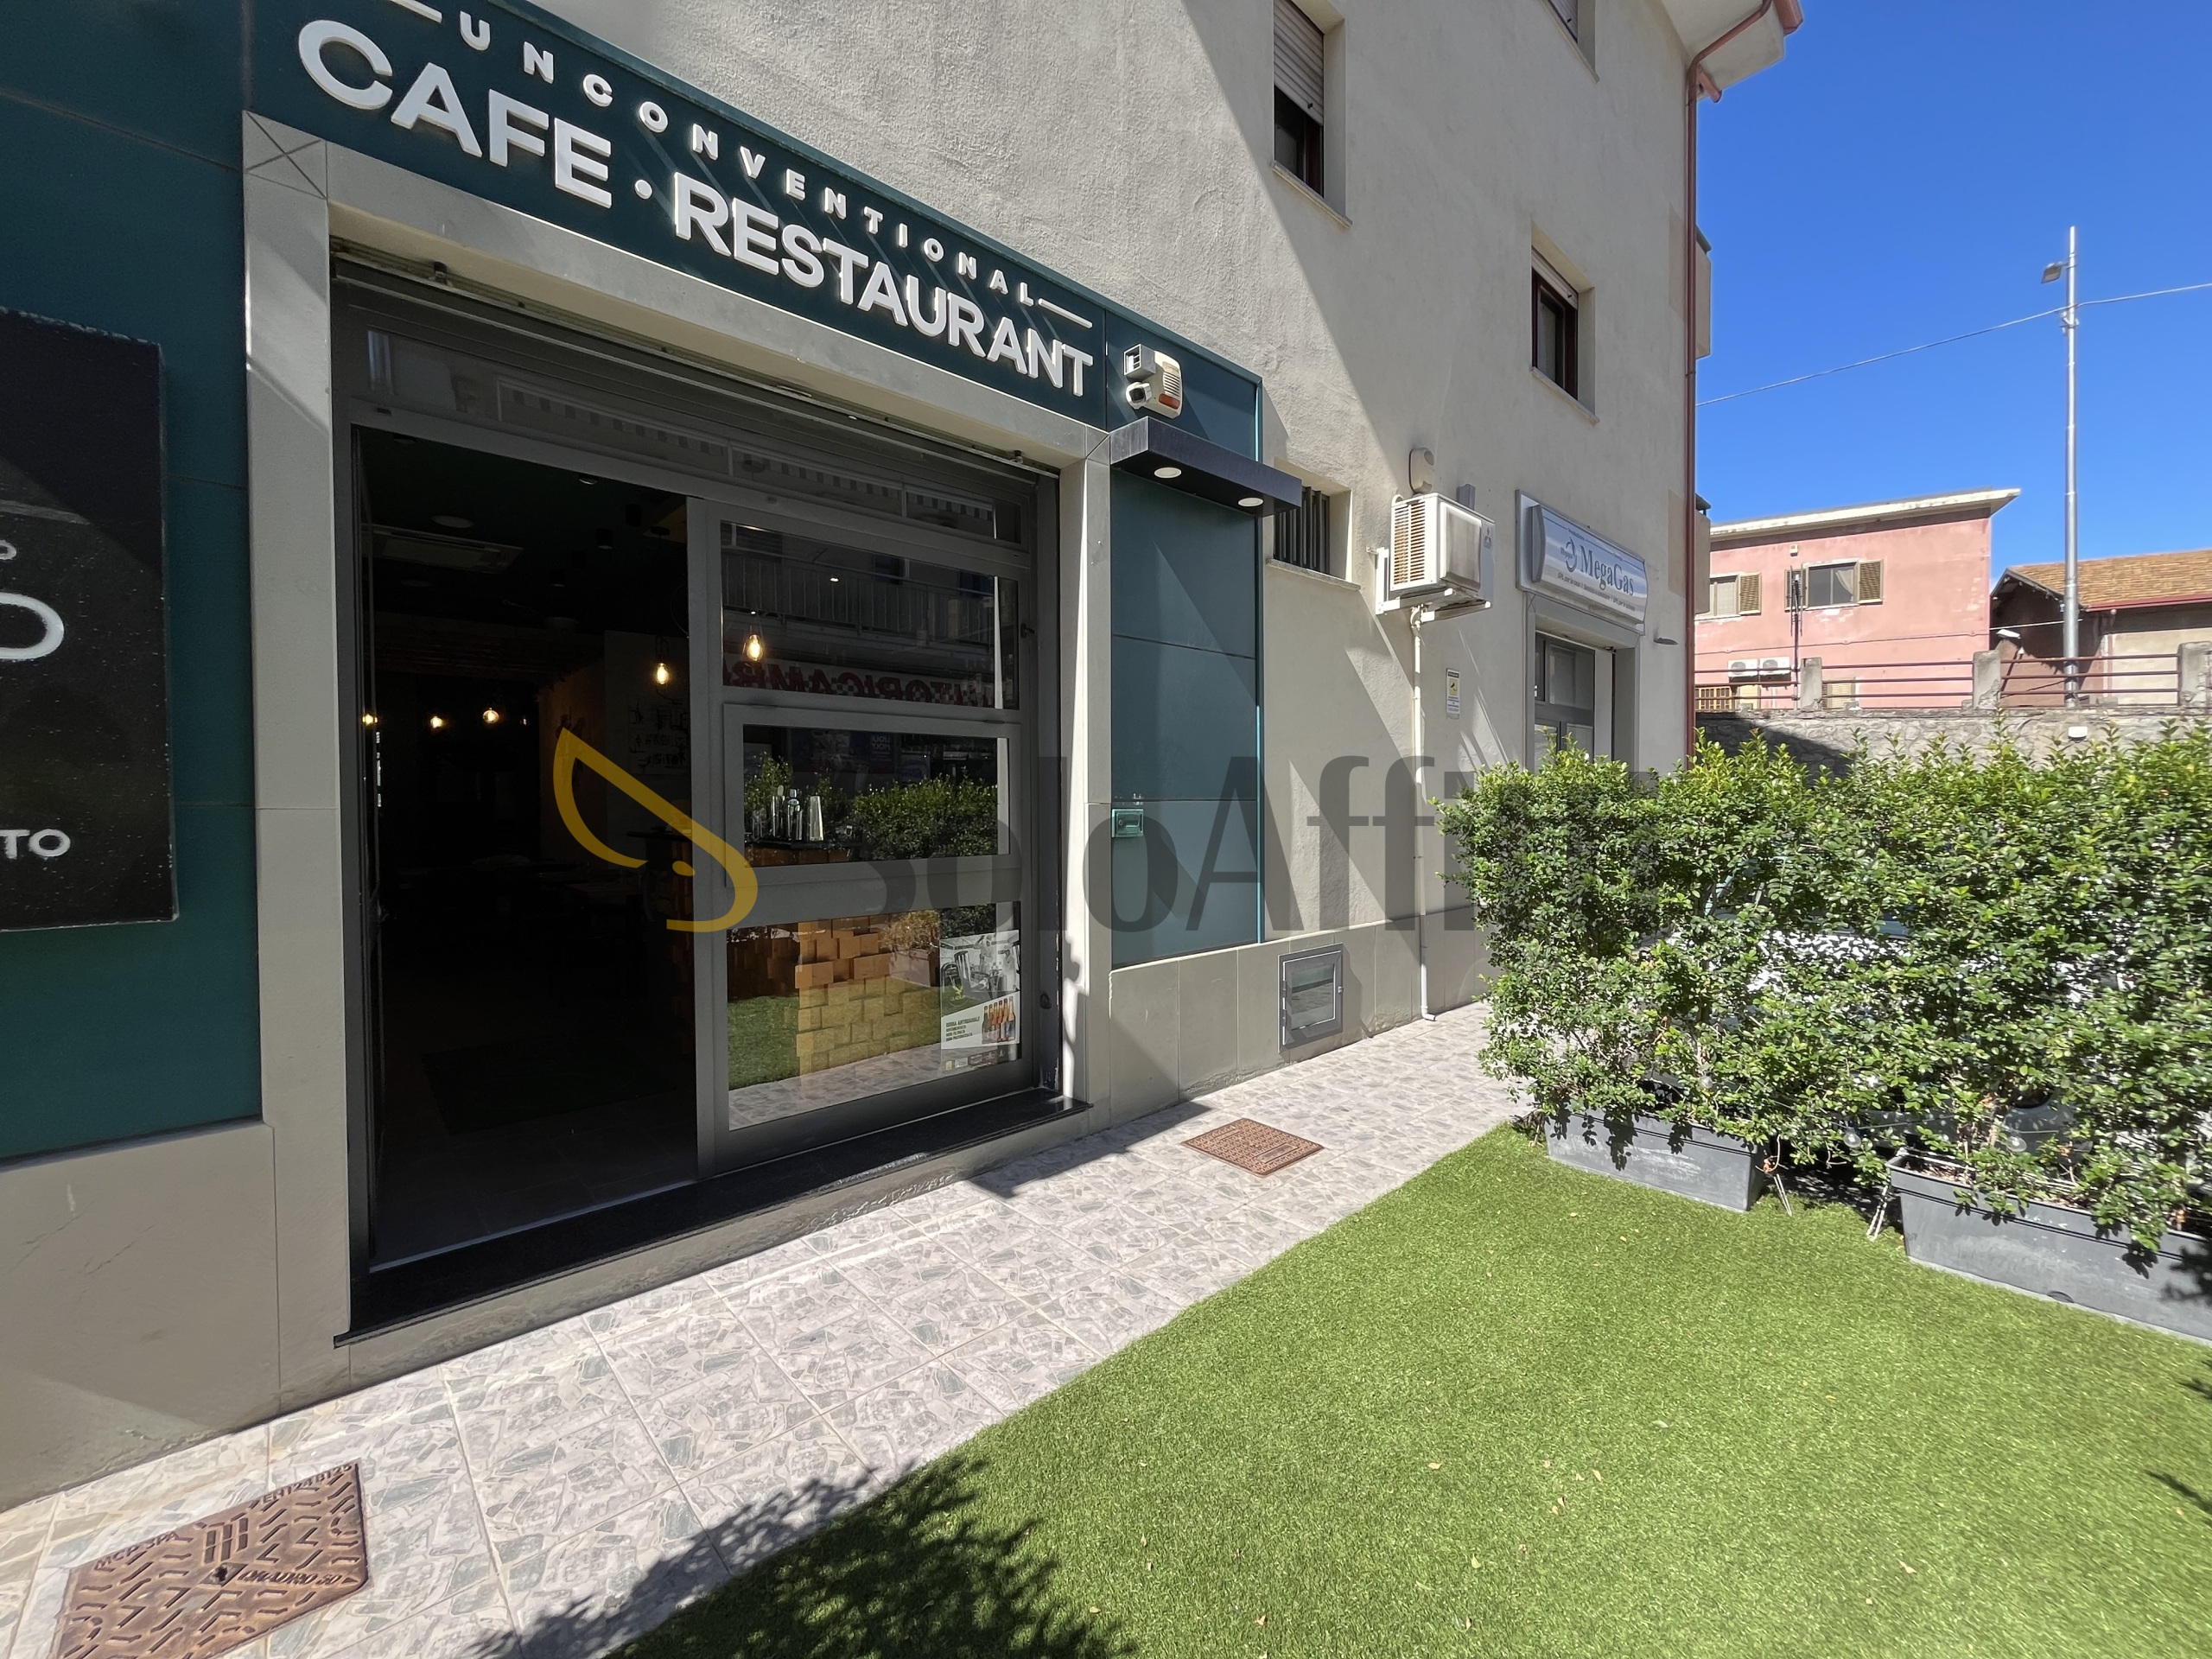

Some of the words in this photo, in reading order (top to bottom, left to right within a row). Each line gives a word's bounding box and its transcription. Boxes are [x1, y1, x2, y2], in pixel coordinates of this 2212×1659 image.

[298, 19, 613, 209] CAFE
[674, 171, 1094, 397] RESTAURANT
[459, 10, 1034, 306] UNCONVENTIONAL
[1580, 544, 1634, 596] MegaGas
